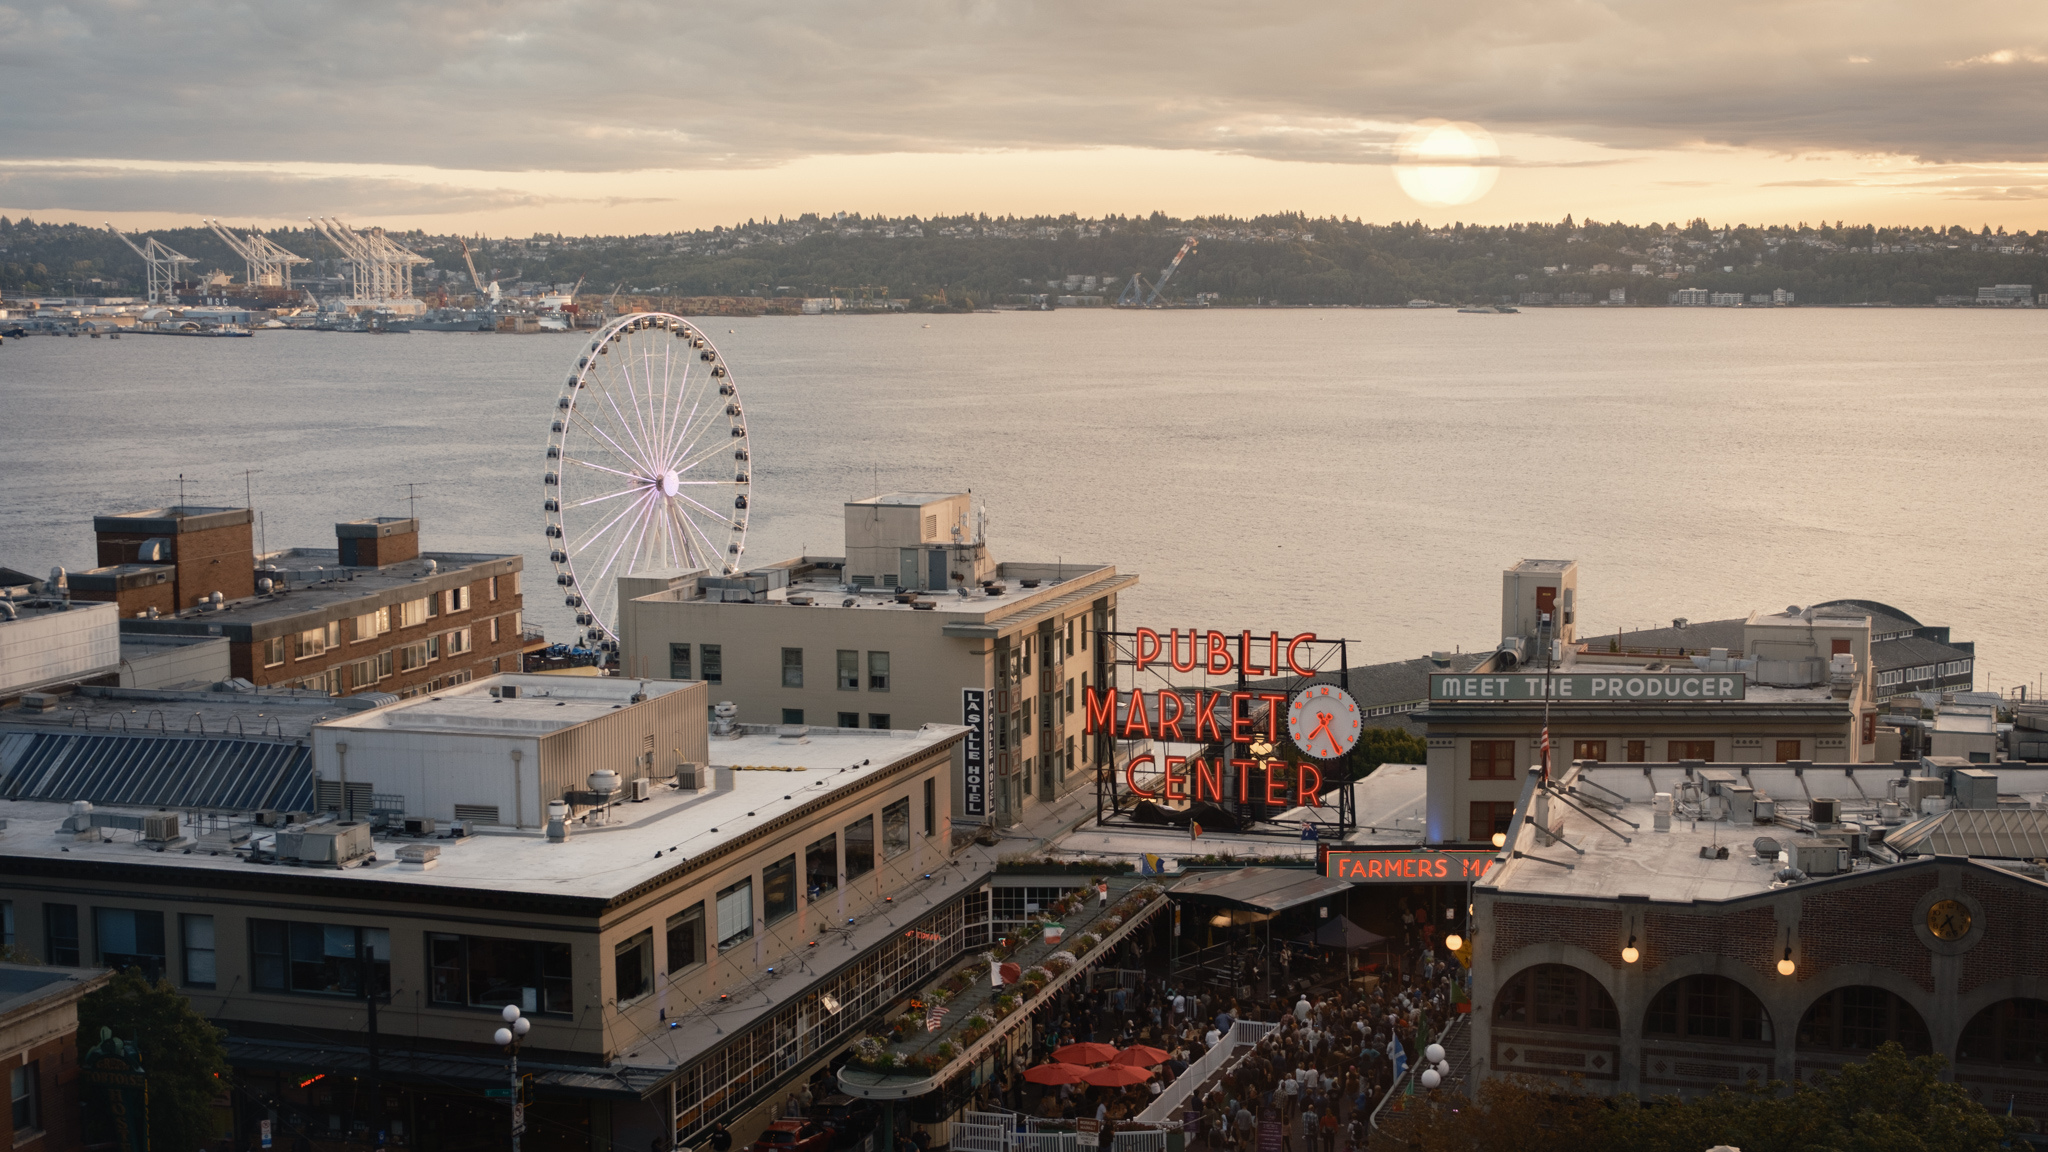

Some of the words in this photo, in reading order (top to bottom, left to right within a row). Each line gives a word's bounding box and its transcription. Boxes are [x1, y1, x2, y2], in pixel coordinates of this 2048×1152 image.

[206, 297, 228, 306] MSC
[1136, 627, 1316, 677] PUBLIC
[1321, 687, 1329, 695] 12
[1442, 677, 1509, 697] MEET
[1525, 677, 1573, 697] THE
[1591, 677, 1735, 697] PRODUCER
[1876, 685, 1897, 697] RIUM
[967, 693, 980, 711] LA
[989, 691, 994, 709] LA
[1349, 704, 1354, 712] 2
[1085, 685, 1289, 743] MARKET
[1290, 717, 1297, 725] 9
[1352, 719, 1358, 728] 3
[1294, 732, 1301, 740] 8
[1347, 735, 1354, 743] 4
[1306, 744, 1312, 752] 7
[1321, 749, 1327, 757] 6
[1125, 755, 1323, 807] CENTER
[967, 766, 981, 812] HOTEL
[1338, 859, 1448, 878] FARMERS
